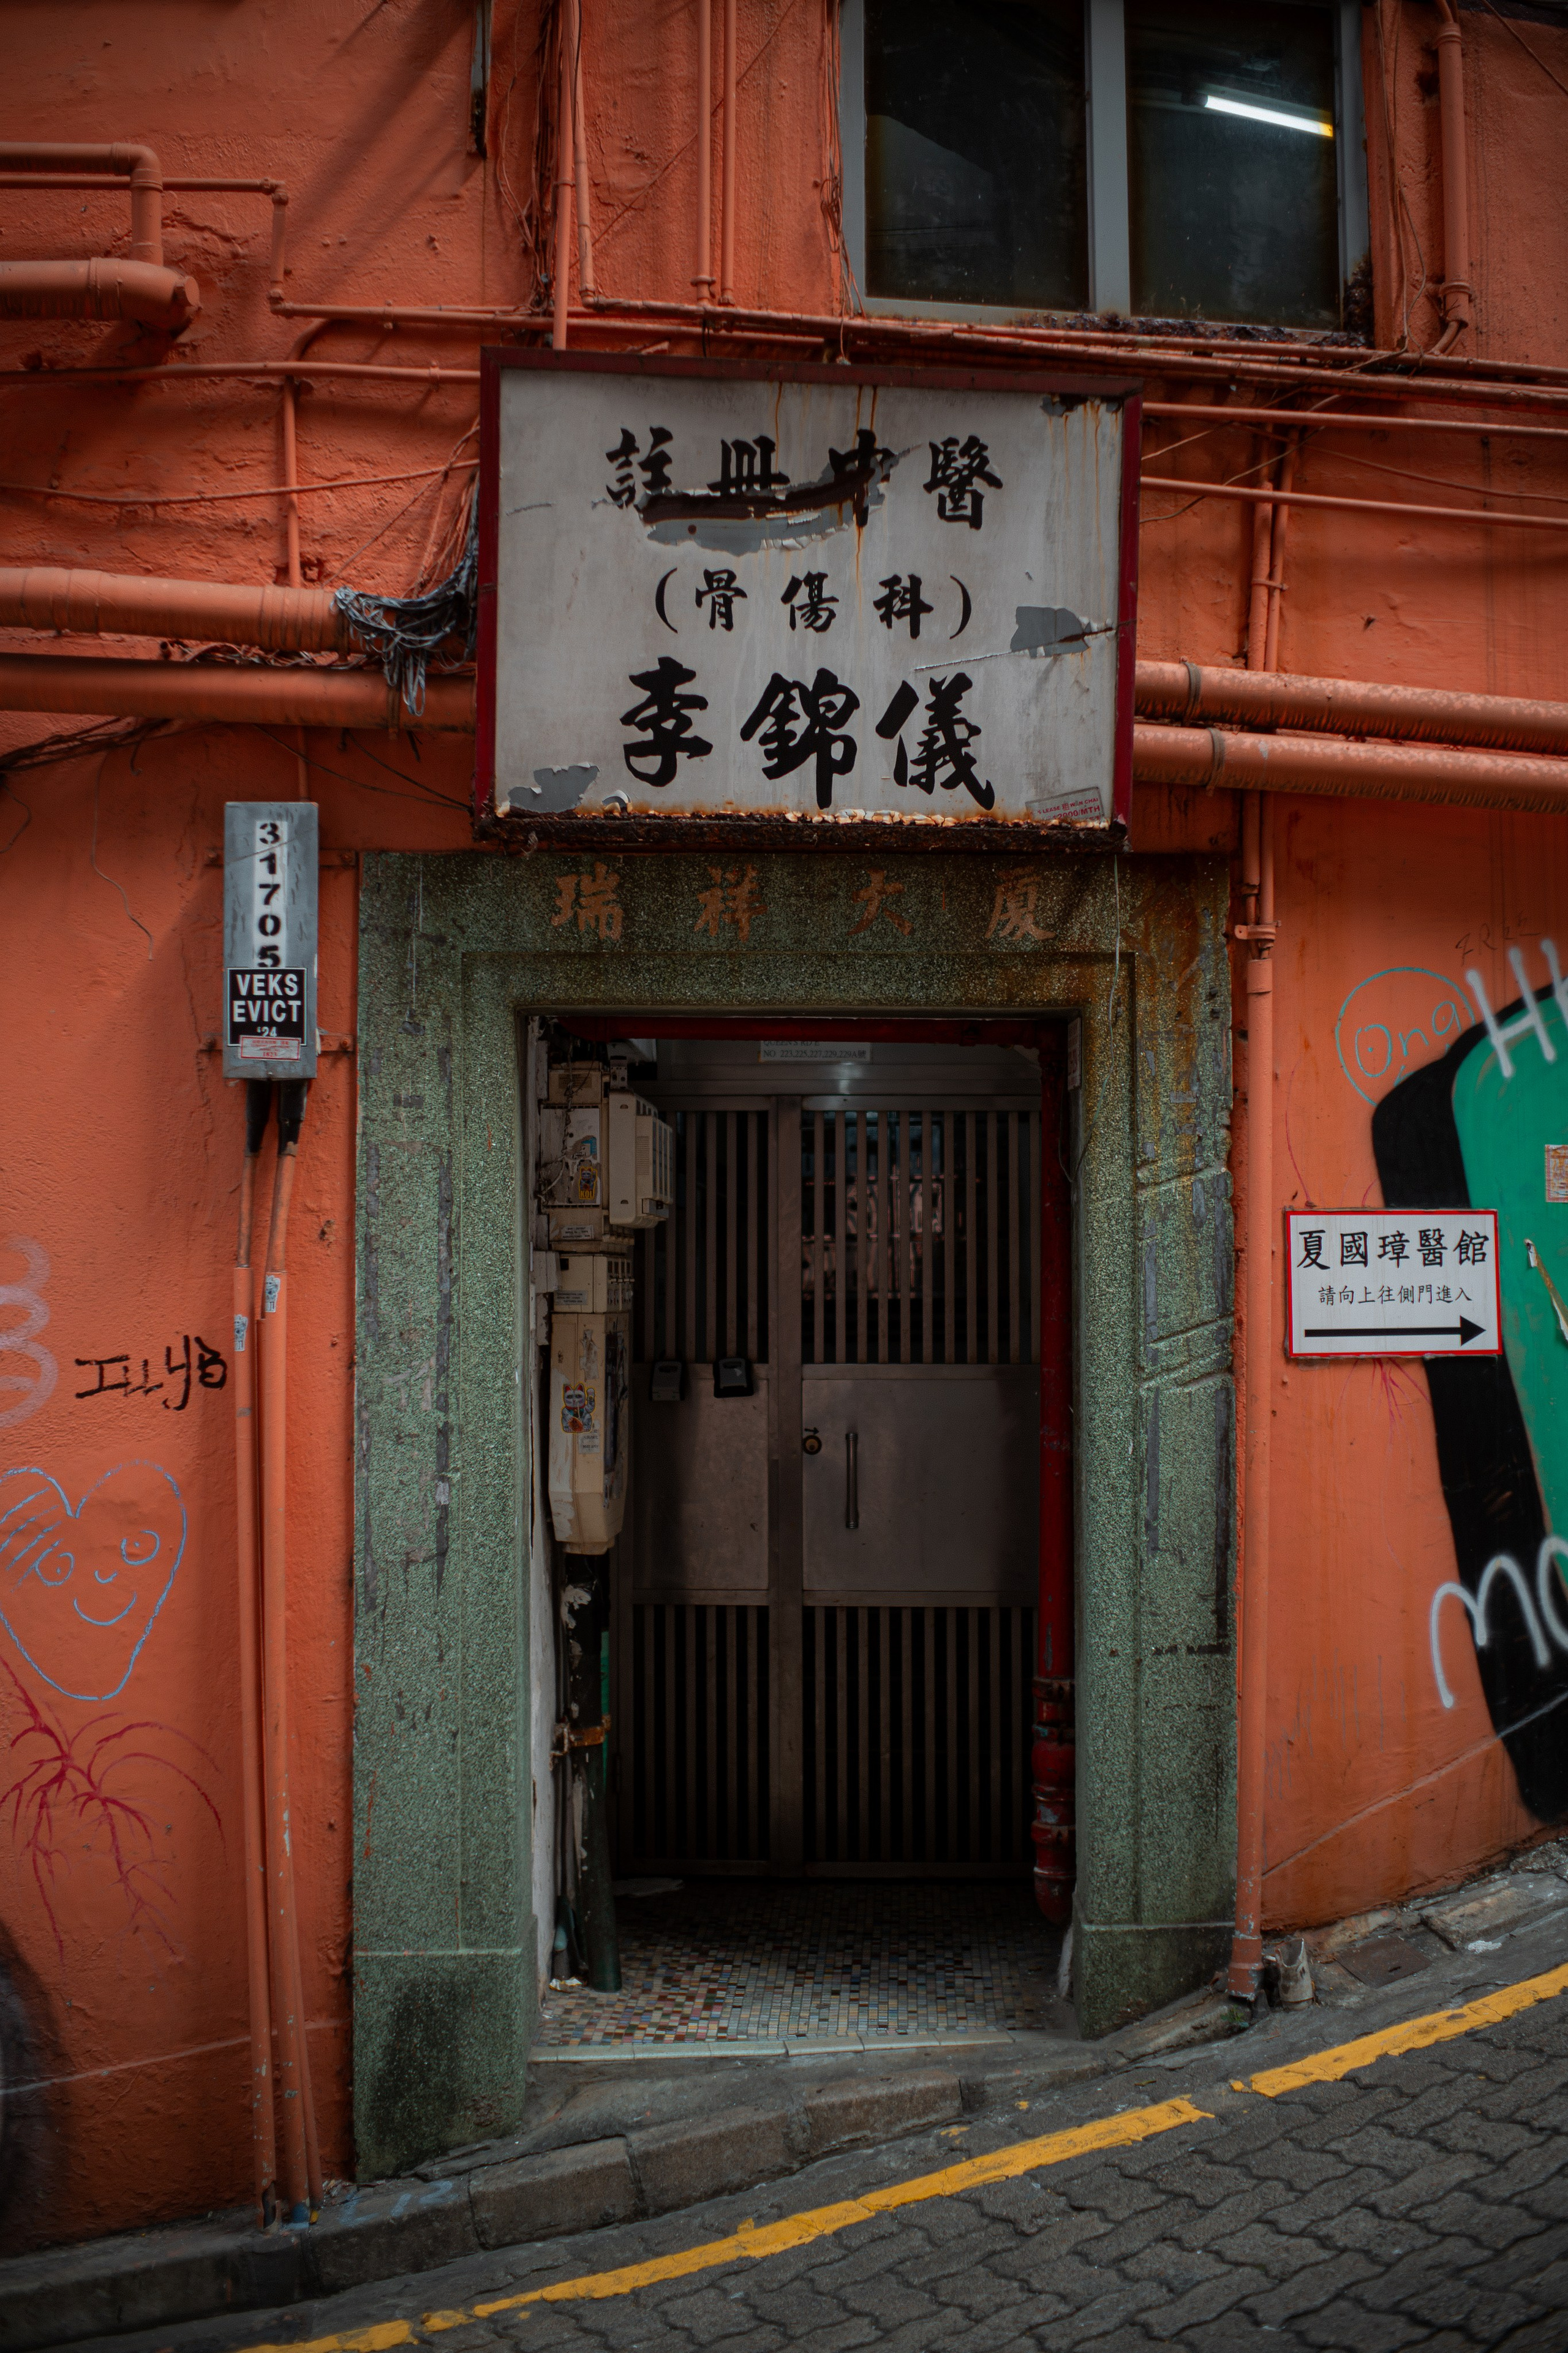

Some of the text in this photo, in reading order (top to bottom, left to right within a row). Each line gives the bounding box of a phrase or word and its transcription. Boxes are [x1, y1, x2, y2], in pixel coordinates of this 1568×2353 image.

[606, 427, 1003, 529] 註冊中醫
[619, 656, 995, 810] 李錦儀
[258, 823, 281, 967] 31705
[551, 861, 1058, 942] 瑞祥大廈
[233, 1000, 301, 1022] EVICT
[236, 973, 298, 996] VEKS
[1297, 1228, 1490, 1271] 夏國璋醫館
[1317, 1285, 1472, 1306] 請向上往側門進入
